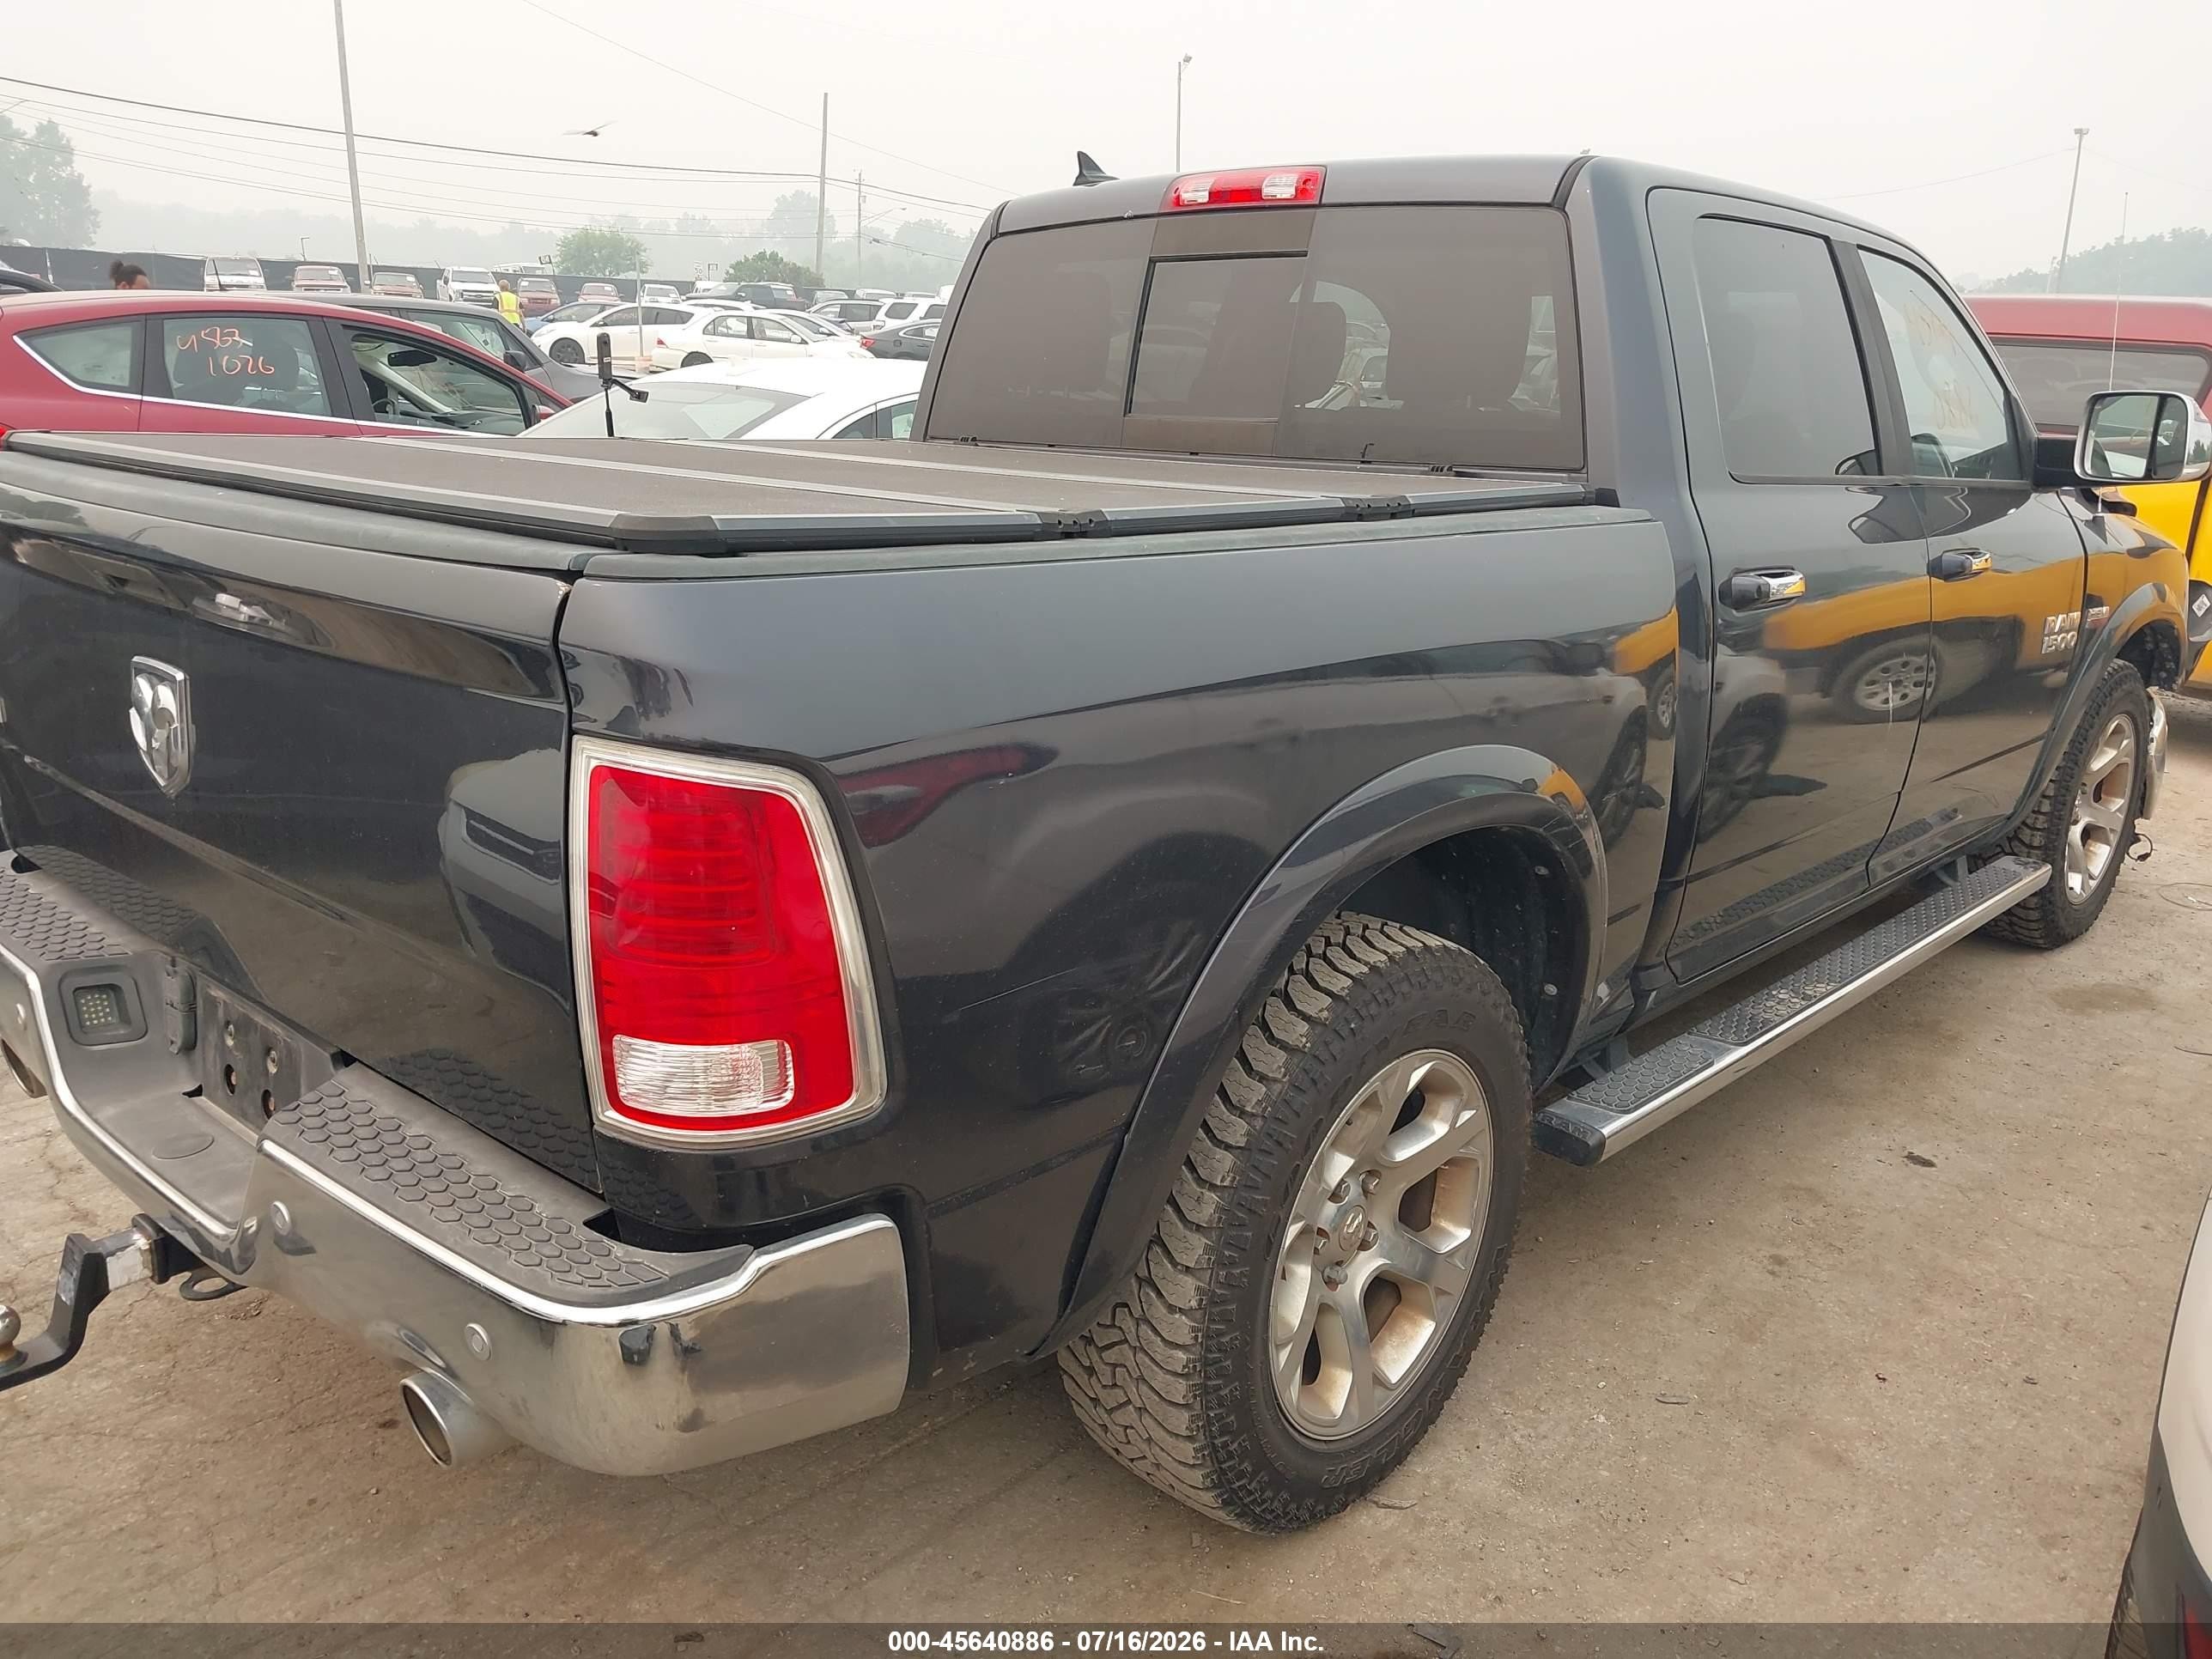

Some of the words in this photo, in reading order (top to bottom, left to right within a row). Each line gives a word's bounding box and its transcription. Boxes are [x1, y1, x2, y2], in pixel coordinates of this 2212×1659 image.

[2044, 611, 2081, 635] RAM
[2040, 631, 2078, 654] 1500
[1320, 1243, 1510, 1489] WRANGLER
